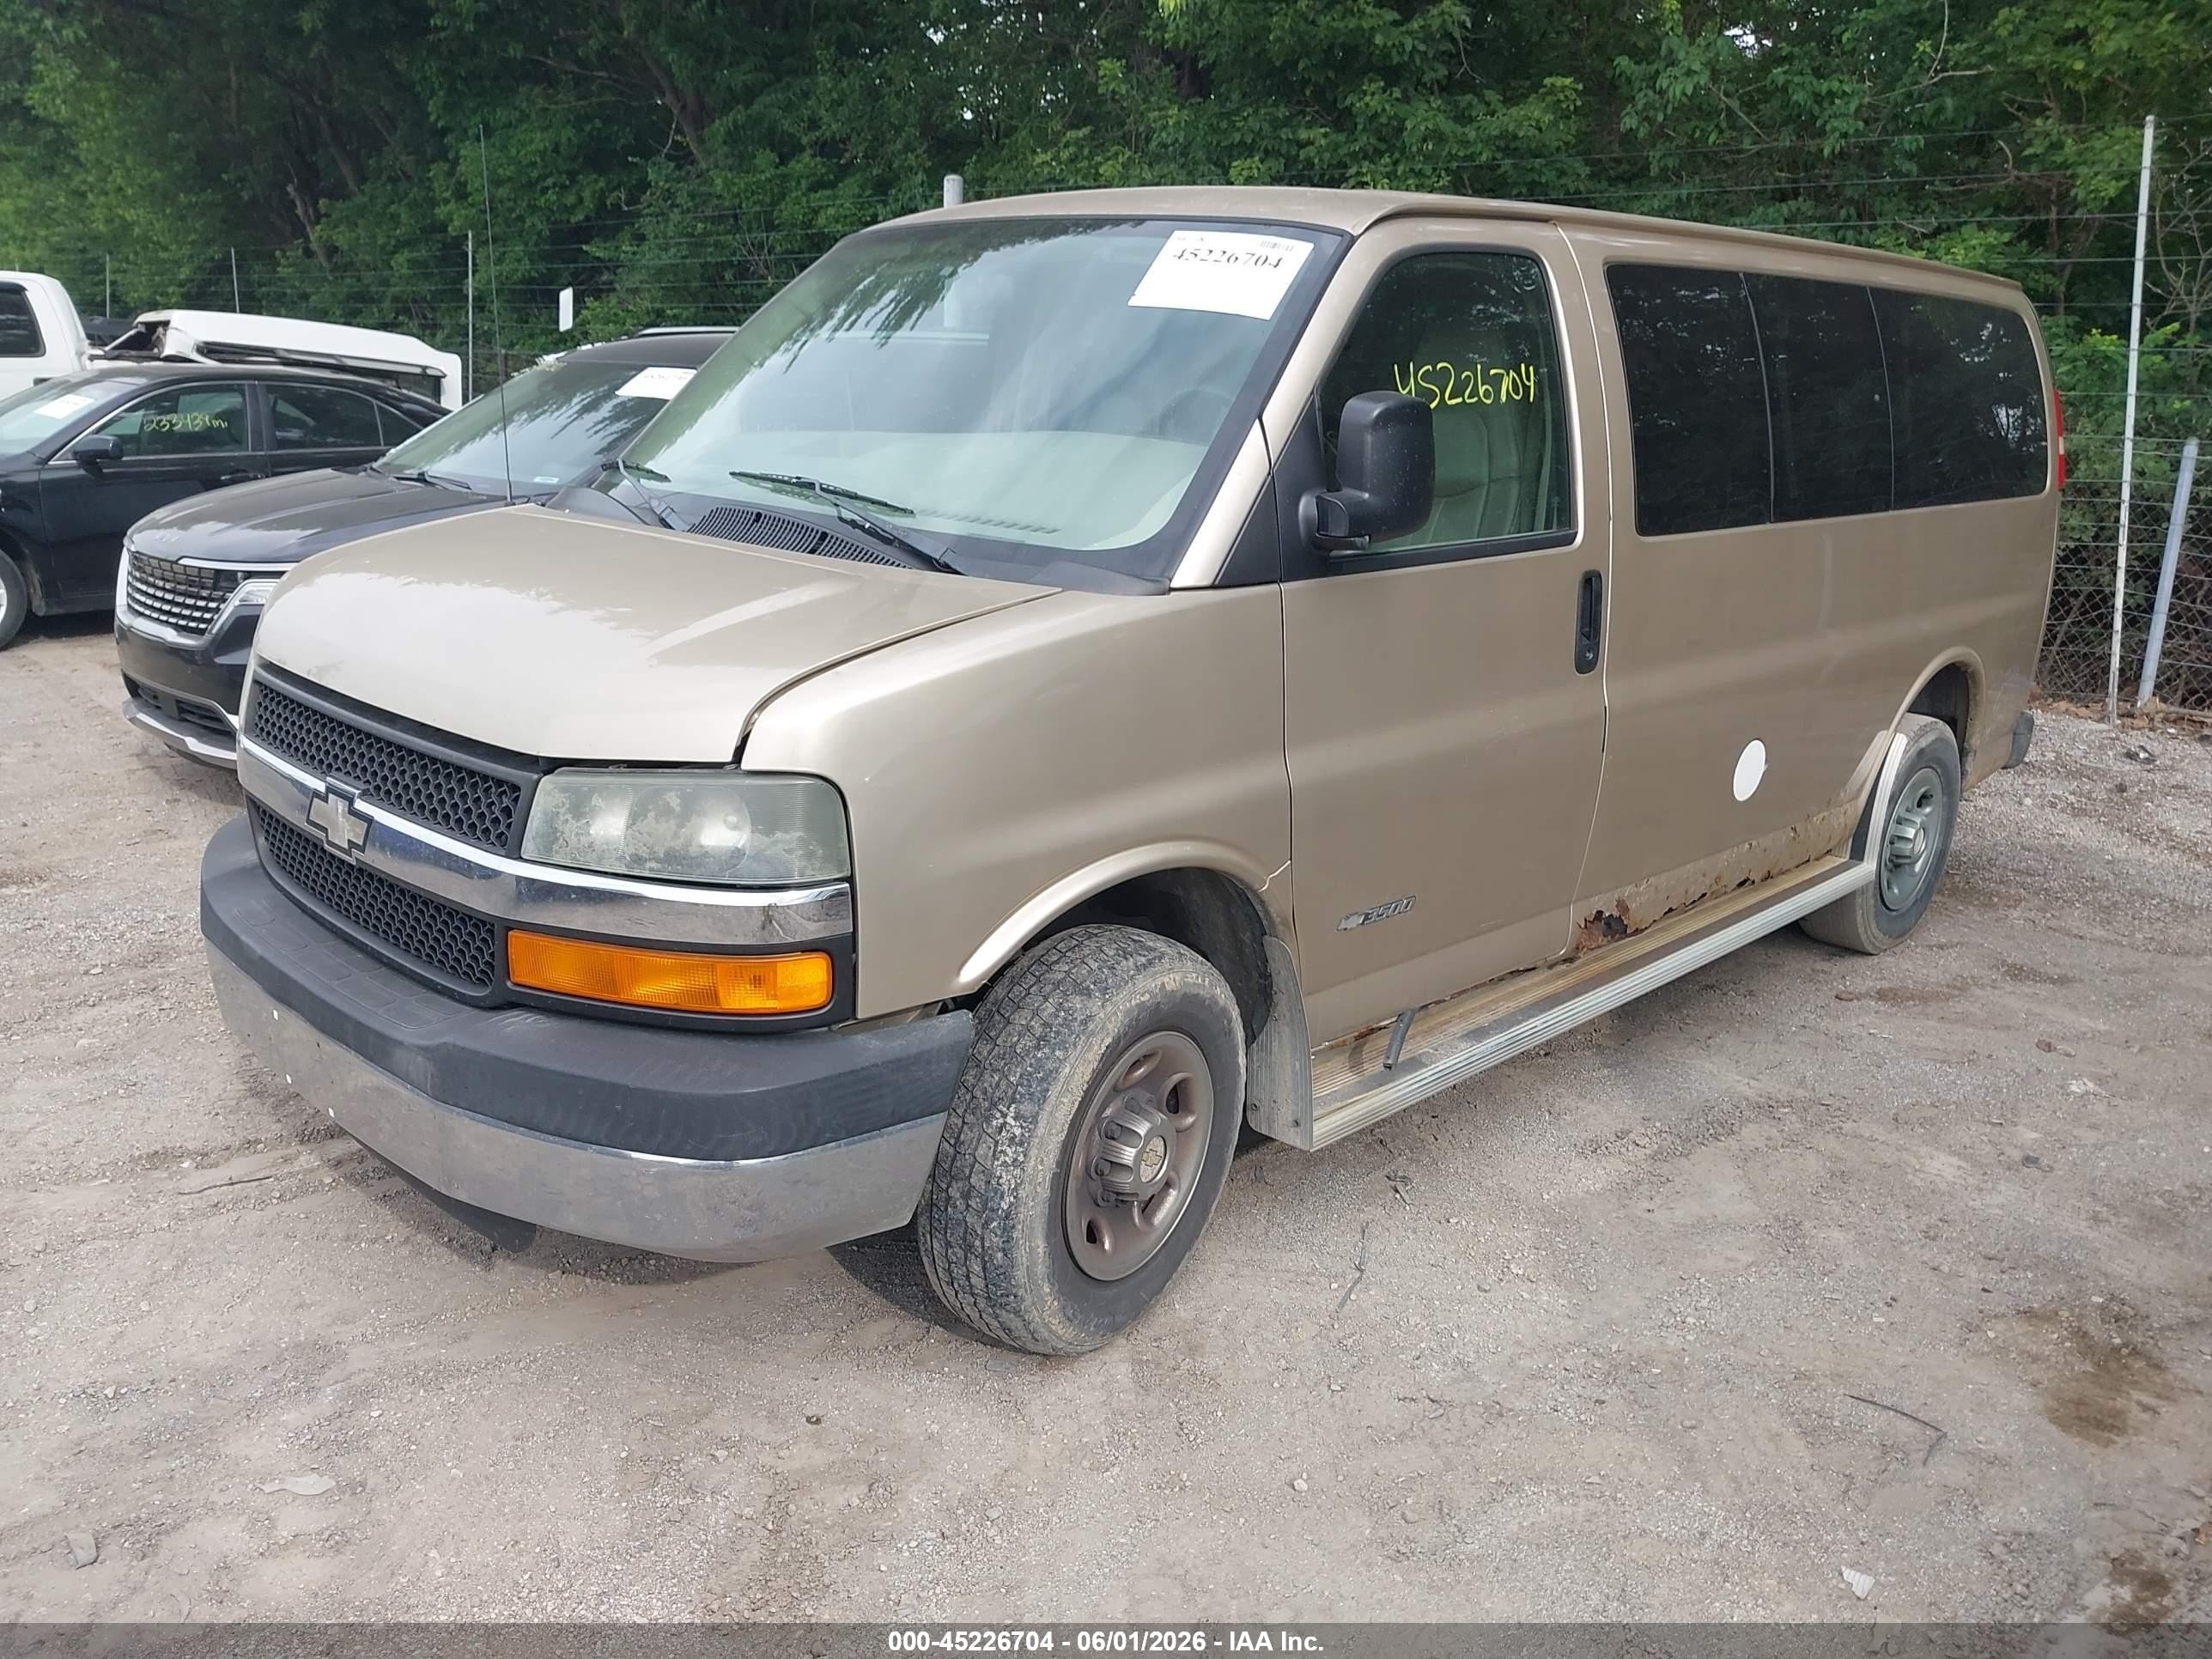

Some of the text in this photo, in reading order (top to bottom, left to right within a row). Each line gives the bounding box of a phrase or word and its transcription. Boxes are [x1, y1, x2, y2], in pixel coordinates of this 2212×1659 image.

[1173, 248, 1283, 268] 45226704
[1395, 362, 1534, 410] 45226704
[1364, 896, 1416, 925] 3500
